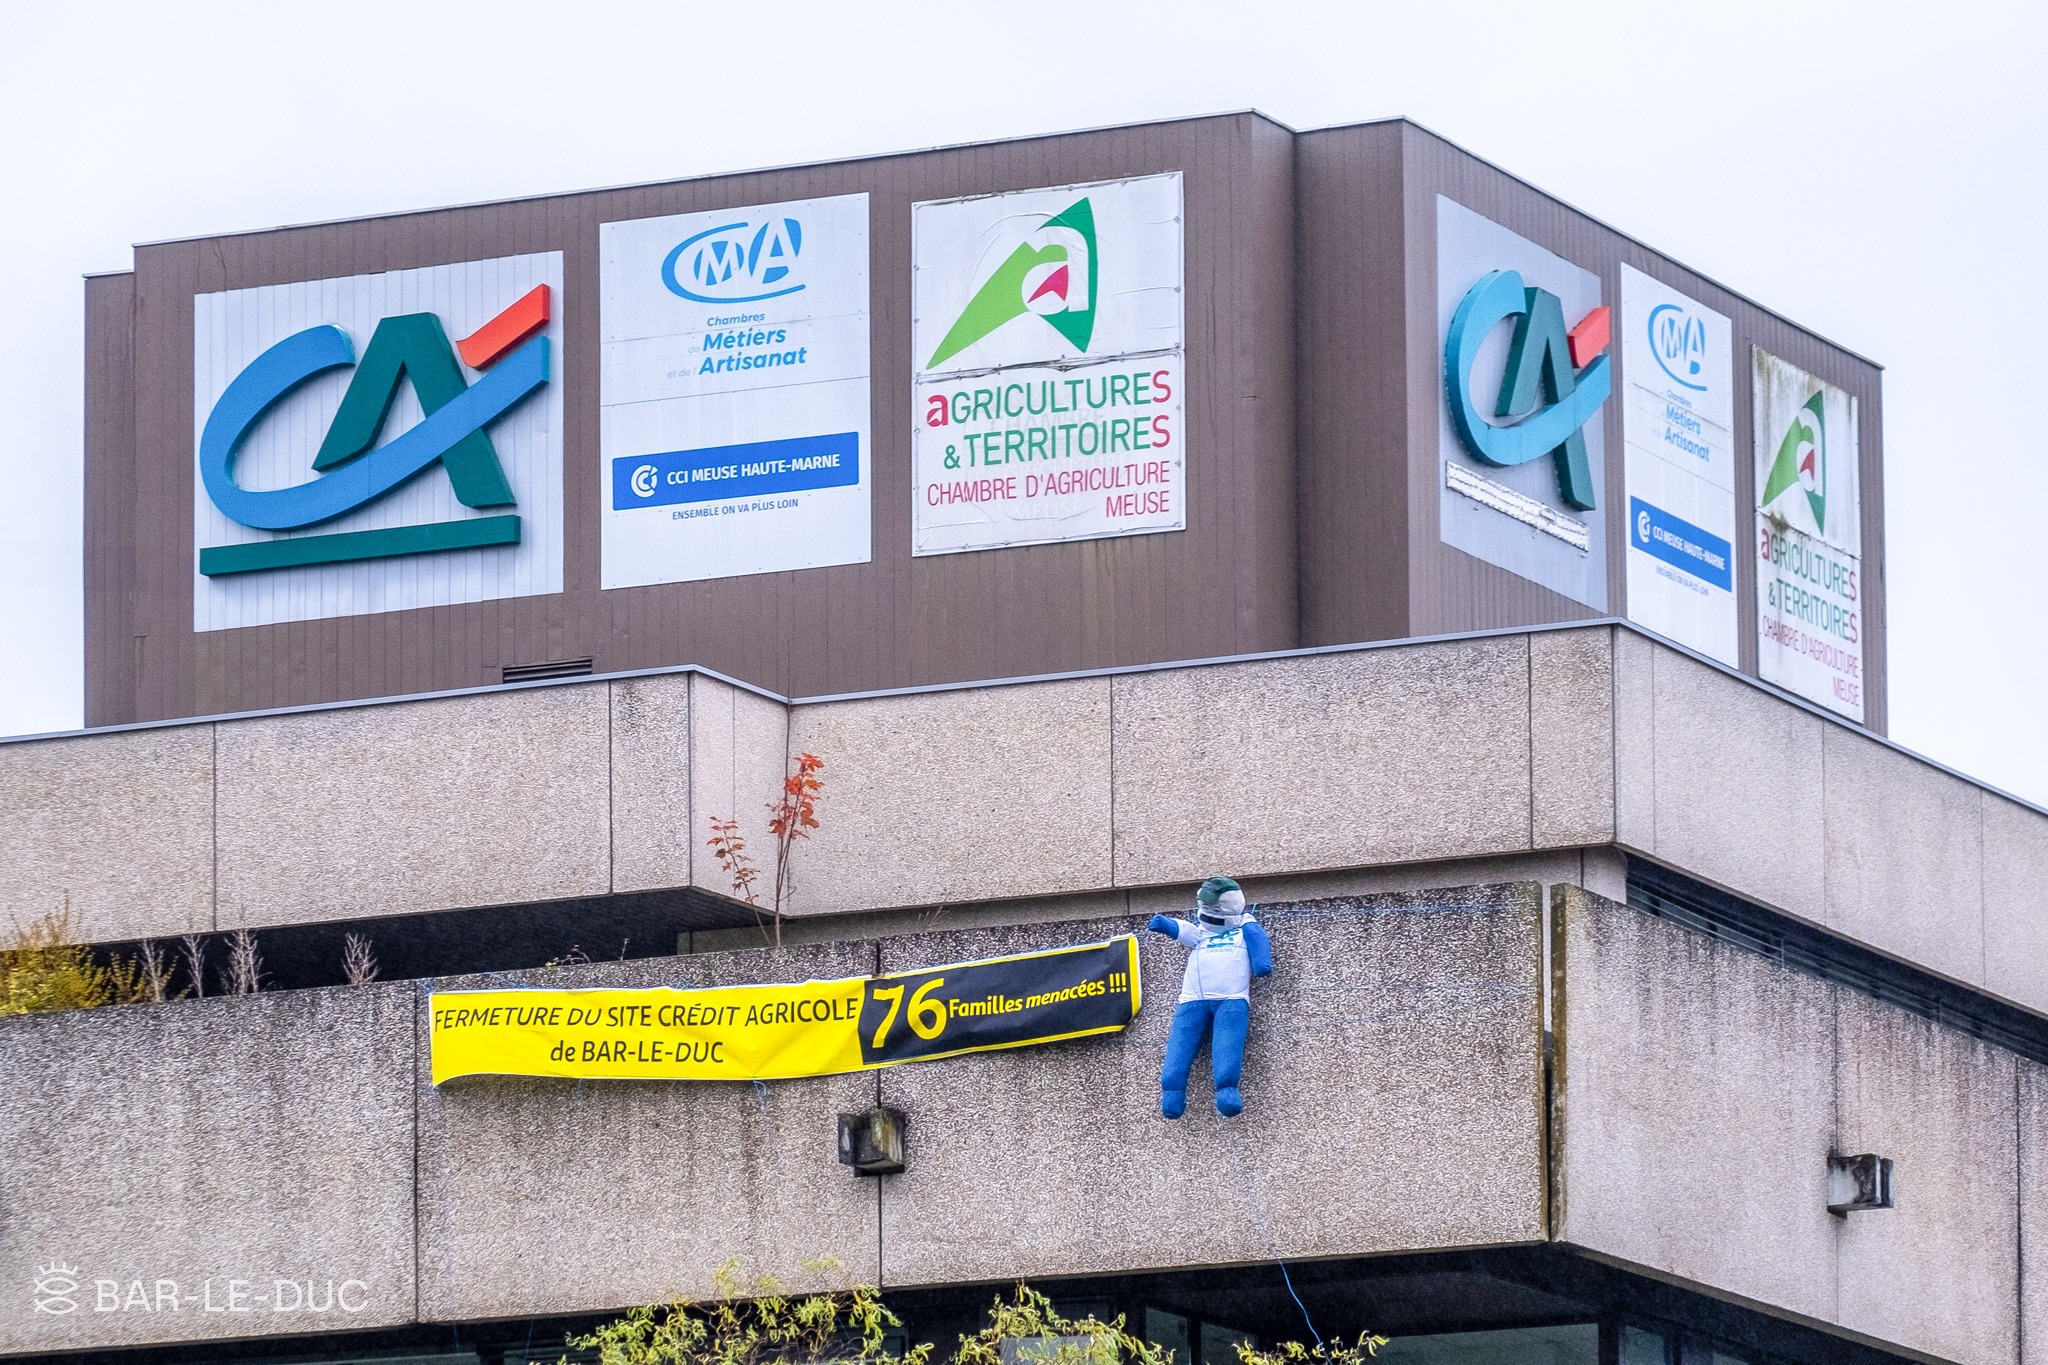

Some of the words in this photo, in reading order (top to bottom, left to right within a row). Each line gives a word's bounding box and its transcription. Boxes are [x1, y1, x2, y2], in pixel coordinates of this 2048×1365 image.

[707, 312, 765, 327] Chambres
[703, 327, 786, 351] Métiers
[698, 347, 807, 376] Artisanat
[943, 444, 961, 470] &
[963, 414, 1171, 467] TERRITOIRES
[667, 471, 689, 485] CCI
[691, 464, 738, 482] MEUSE
[741, 453, 841, 477] HAUTE-MARNE
[927, 477, 1017, 506] CHAMBRE
[1025, 460, 1170, 498] D'AGRICULTURE
[672, 508, 720, 520] ENSEMBLE
[722, 505, 736, 515] ON
[738, 503, 750, 513] VA
[752, 500, 775, 512] PLUS
[778, 498, 799, 509] LOIN
[1105, 490, 1170, 518] MEUSE
[1768, 581, 1776, 607] &
[1776, 577, 1858, 644] TERRITOIRES
[1763, 615, 1800, 652] CHAMBRE
[1832, 676, 1860, 707] MEUSE
[434, 1007, 564, 1033] FERMETURE
[566, 1007, 602, 1027] DU
[605, 1005, 651, 1027] SITE
[657, 1002, 740, 1027] CRÉDIT
[743, 997, 859, 1028] AGRICOLE
[872, 977, 948, 1048] 76
[949, 994, 1023, 1019] Familles
[1025, 979, 1106, 1010] menacées
[1109, 972, 1128, 994] !!!
[550, 1040, 576, 1063] de
[581, 1041, 725, 1064] BAR-LE-DUC
